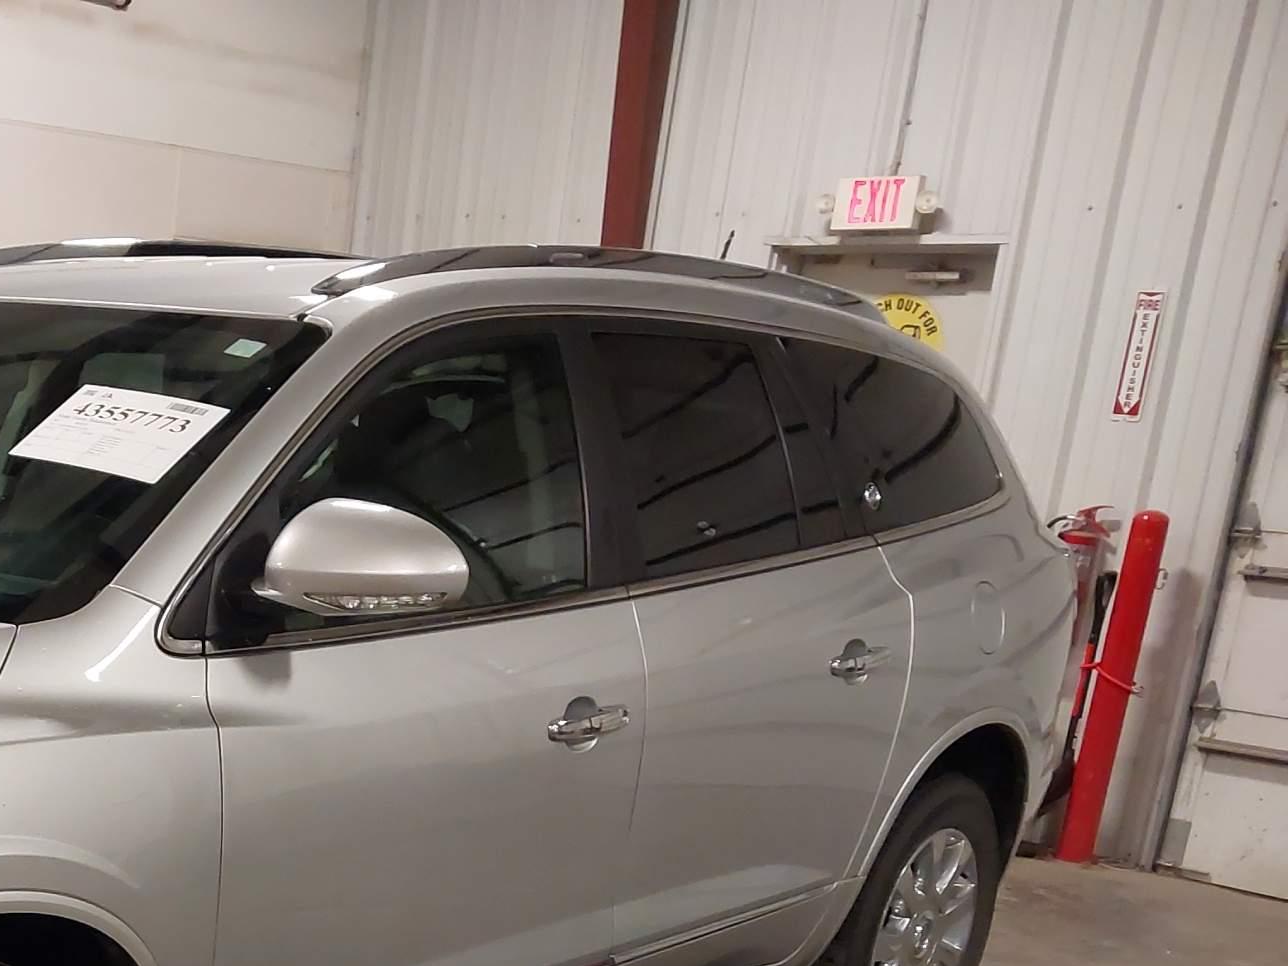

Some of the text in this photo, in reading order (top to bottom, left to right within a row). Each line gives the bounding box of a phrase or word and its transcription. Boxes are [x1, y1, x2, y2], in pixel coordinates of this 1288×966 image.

[848, 179, 905, 224] EXIT
[896, 298, 922, 314] OUT
[918, 310, 938, 336] FOR
[1136, 299, 1160, 311] FIRE
[1123, 312, 1151, 409] EXTINGUISHER
[73, 402, 191, 433] 43557773
